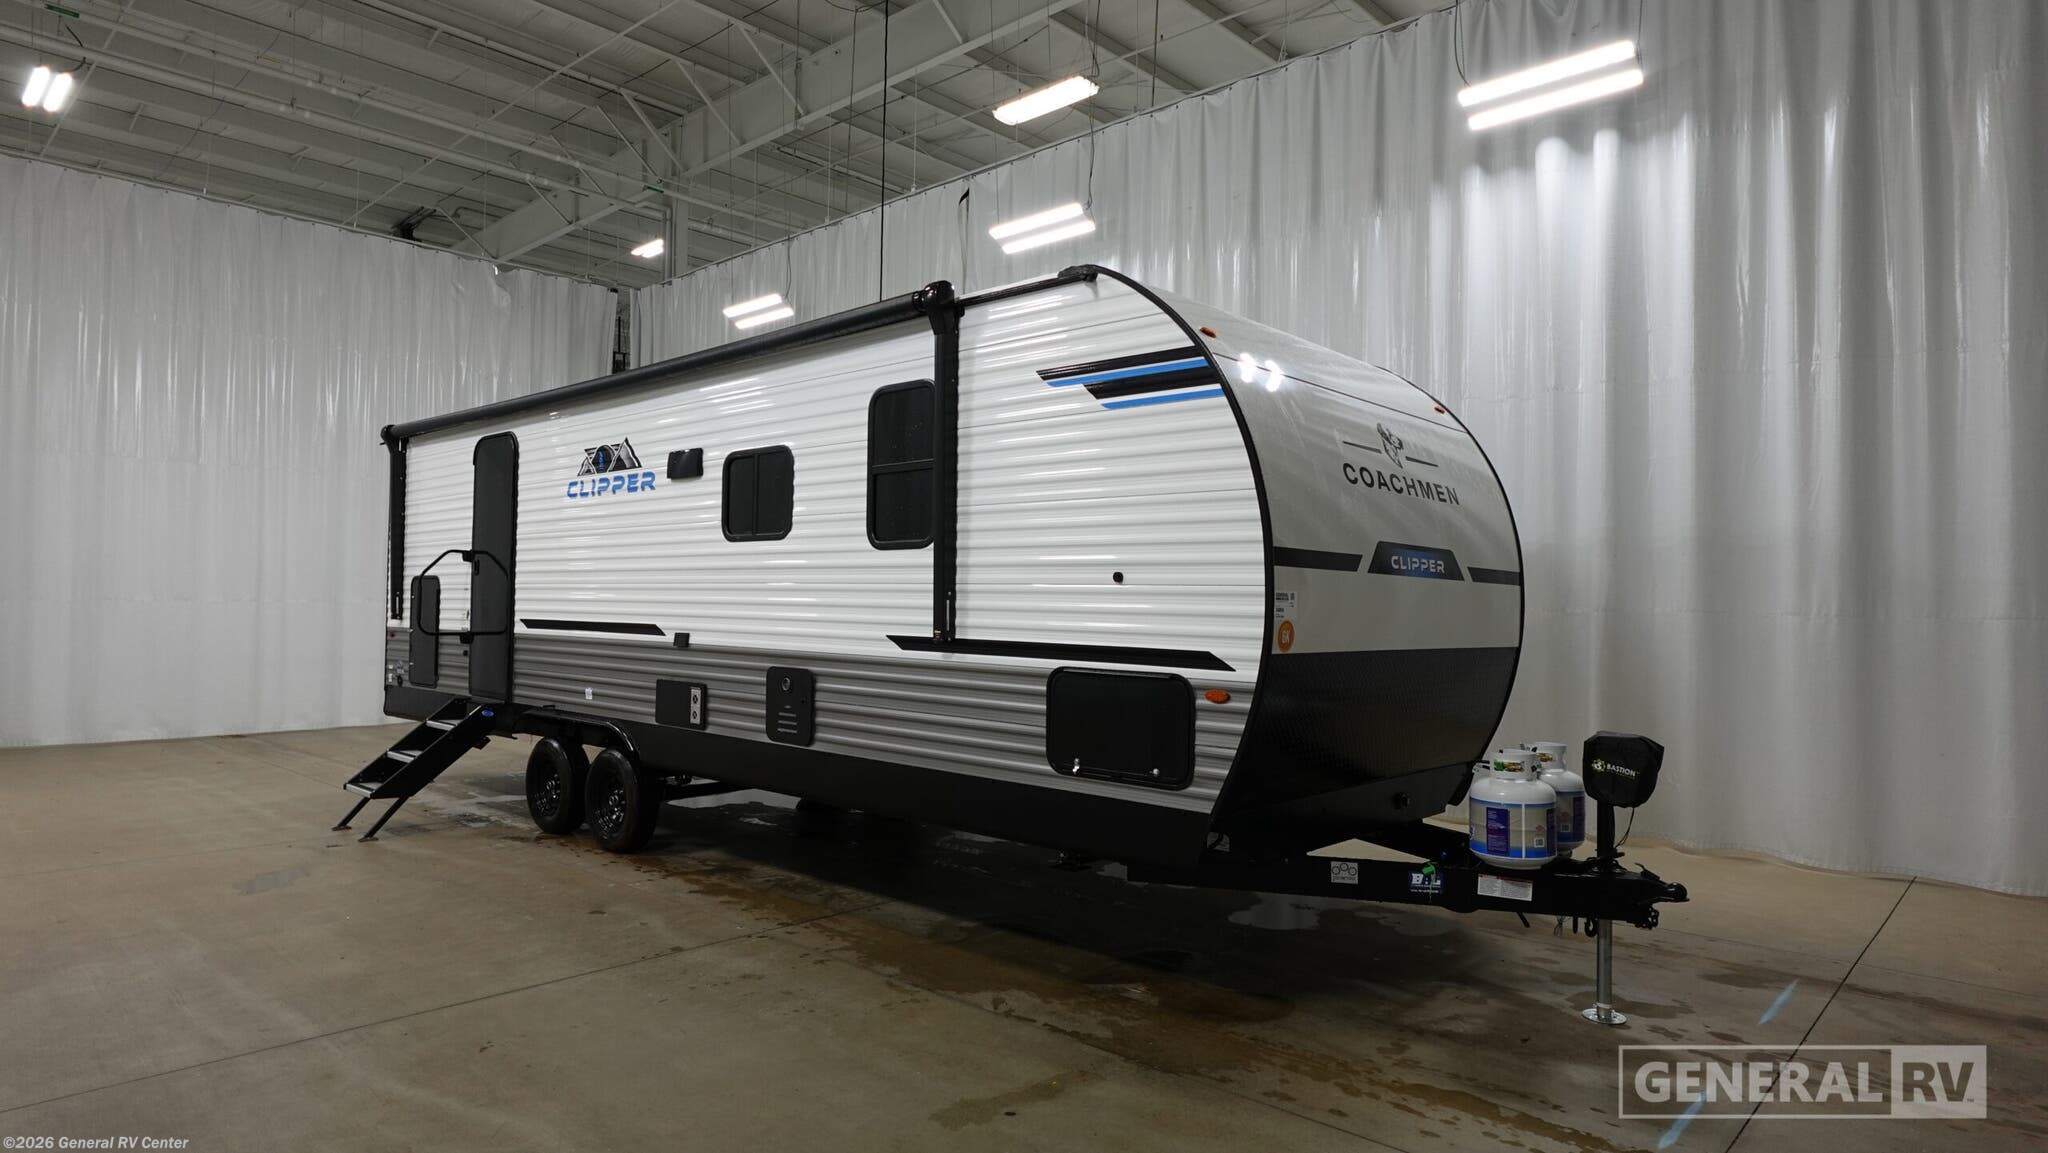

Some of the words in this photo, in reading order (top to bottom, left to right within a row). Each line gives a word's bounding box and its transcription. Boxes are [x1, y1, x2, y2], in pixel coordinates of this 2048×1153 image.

[566, 471, 656, 498] CLIPPER
[1342, 462, 1460, 505] COACHMEN
[1391, 555, 1445, 573] CLIPPER
[1606, 763, 1636, 777] BASTION
[1411, 873, 1441, 885] BL
